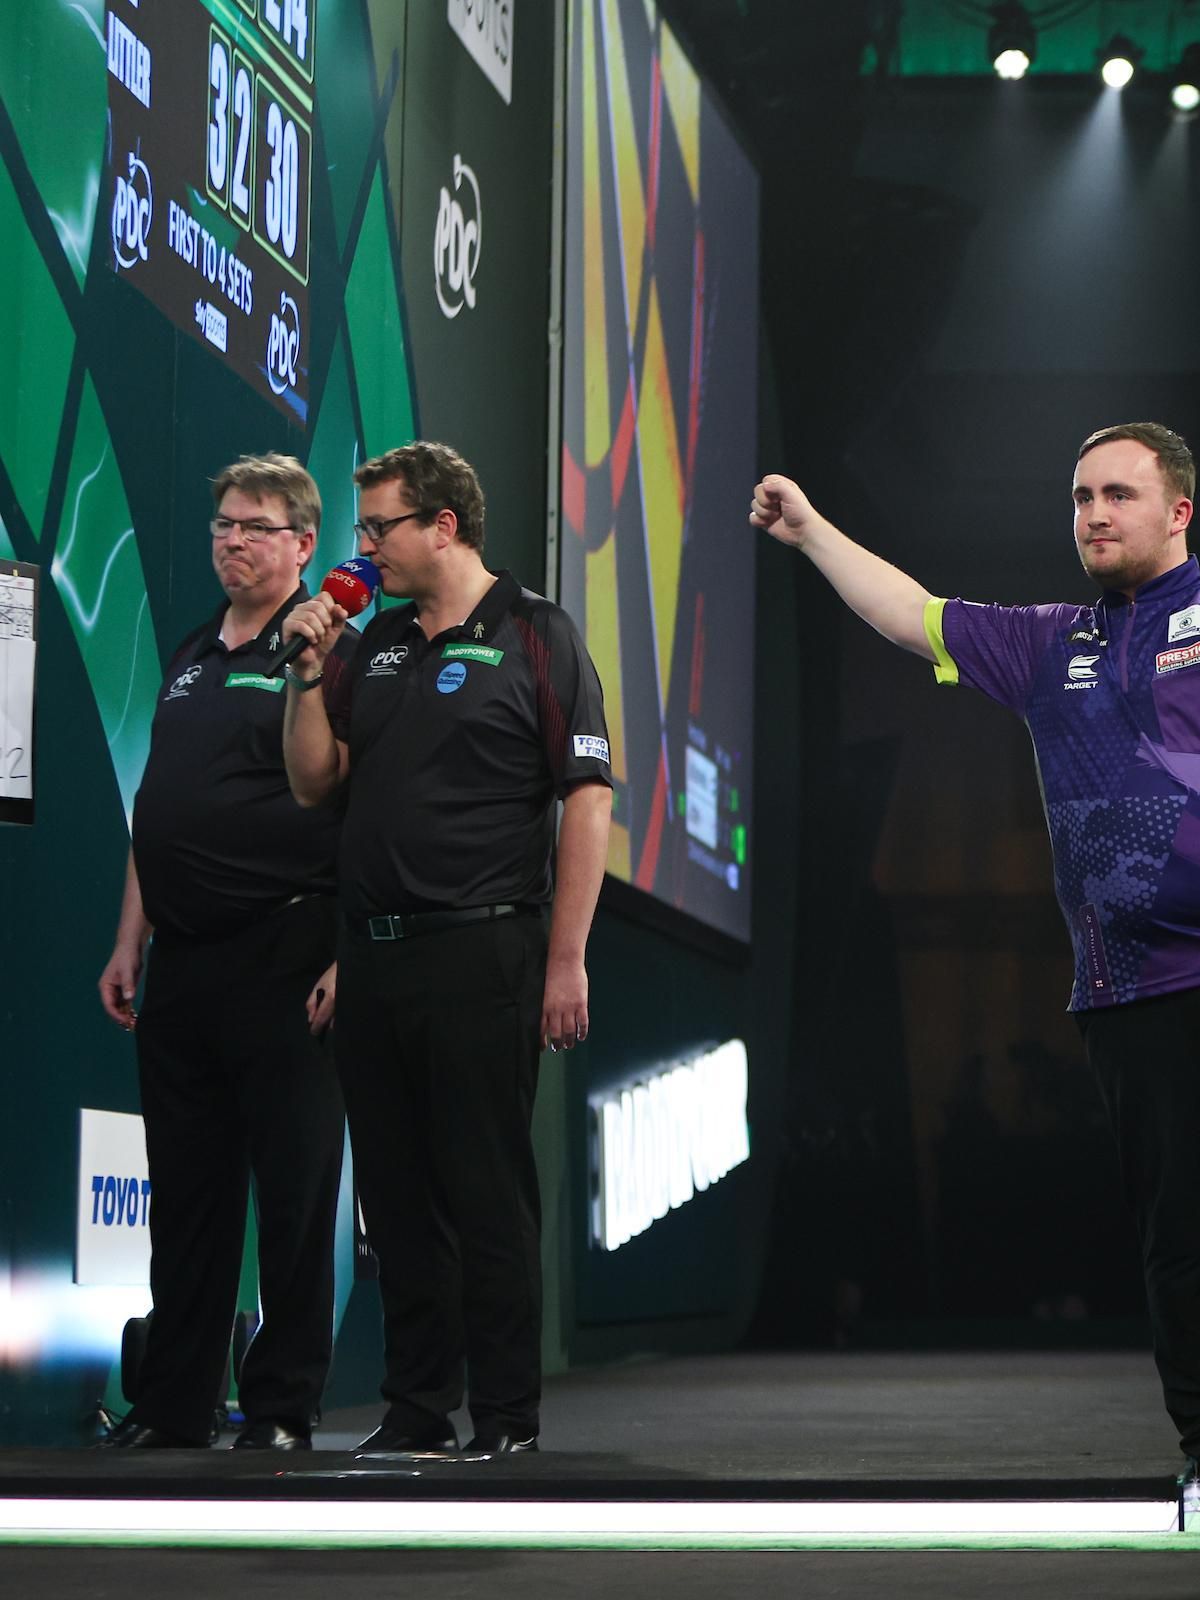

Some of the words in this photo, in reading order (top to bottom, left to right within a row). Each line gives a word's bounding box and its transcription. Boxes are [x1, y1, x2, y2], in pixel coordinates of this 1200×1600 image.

[107, 11, 151, 109] LITTLER
[209, 42, 228, 191] 3
[232, 68, 251, 214] 2
[266, 102, 299, 259] 30
[115, 175, 150, 262] PDC
[438, 186, 478, 310] PDC
[168, 200, 200, 268] FIRST
[201, 229, 217, 284] TO
[218, 246, 227, 293] 4
[227, 253, 253, 316] SETS
[269, 313, 297, 387] PDC
[342, 561, 363, 573] sky
[374, 652, 405, 664] PDC
[446, 647, 496, 659] PADDYPOWER
[1063, 681, 1098, 691] TARGET
[578, 737, 606, 749] TOYO
[585, 746, 608, 760] TIRES
